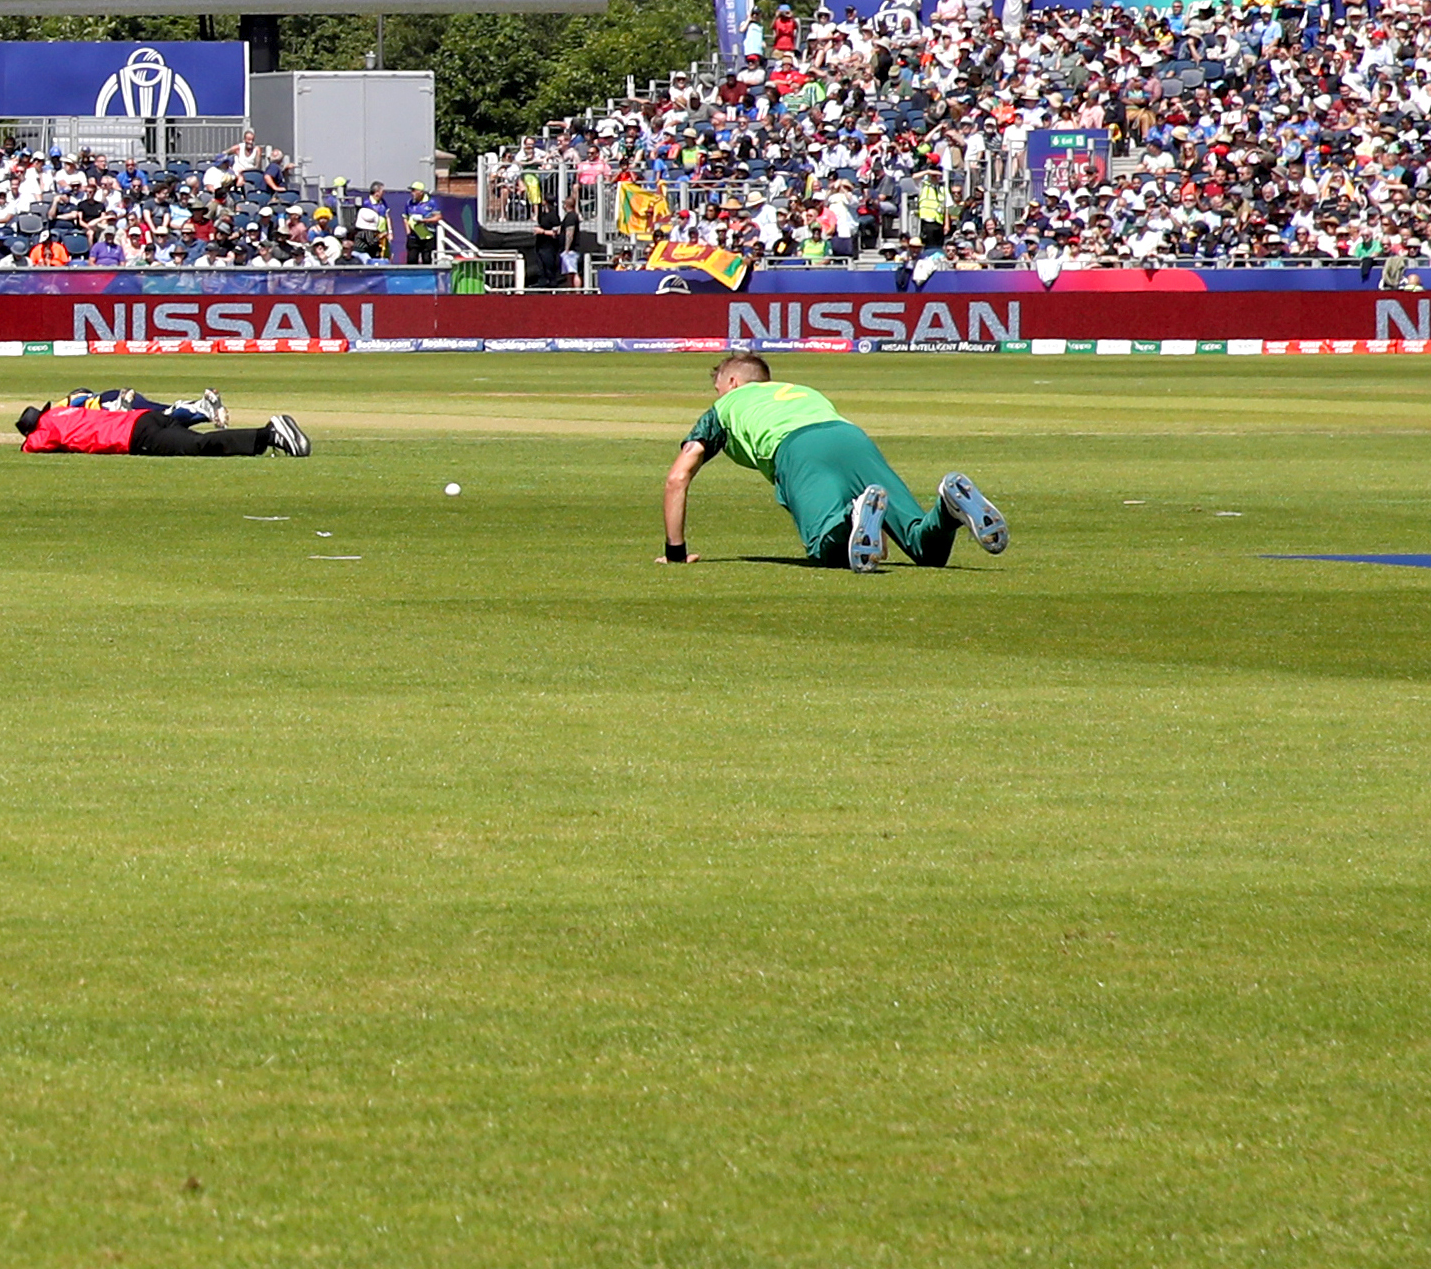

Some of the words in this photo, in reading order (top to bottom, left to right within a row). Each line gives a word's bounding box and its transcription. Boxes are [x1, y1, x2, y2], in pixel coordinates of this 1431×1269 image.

[73, 302, 374, 339] NISSAN
[728, 300, 1020, 340] NISSAN
[422, 339, 478, 350] Booking.com
